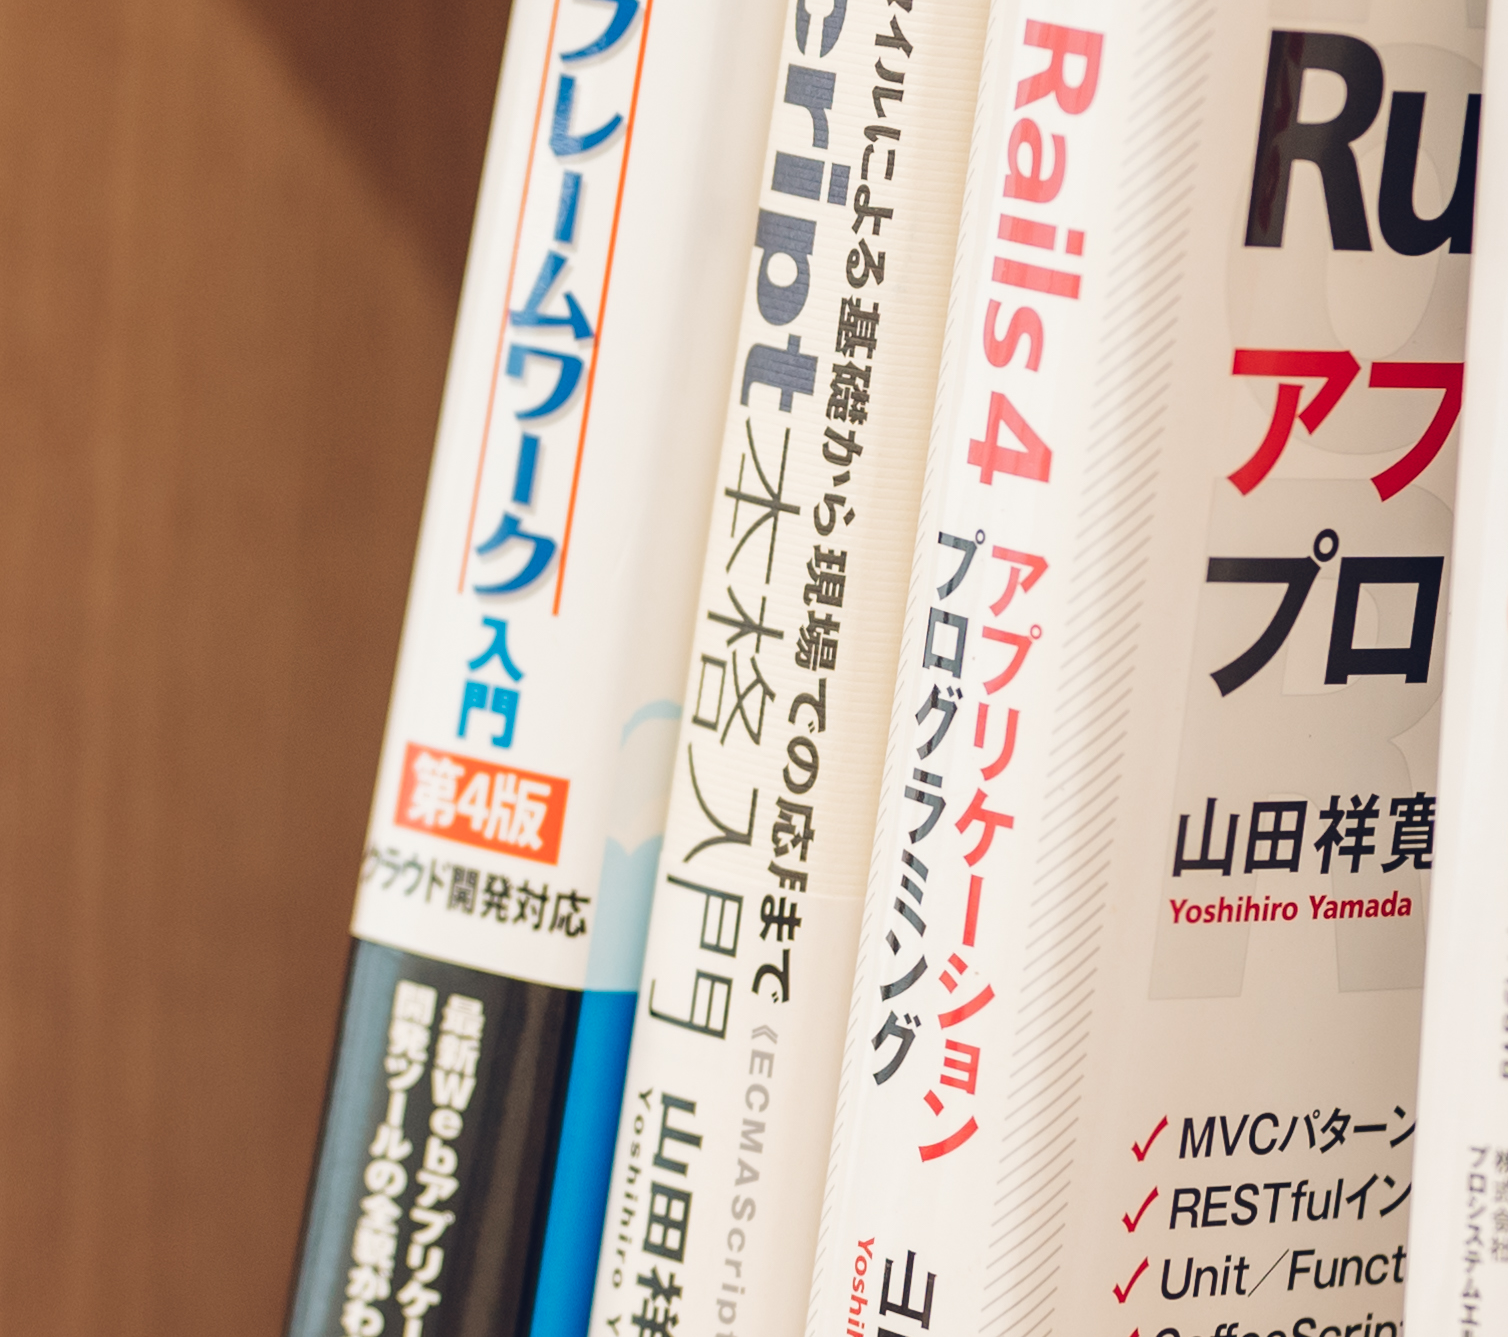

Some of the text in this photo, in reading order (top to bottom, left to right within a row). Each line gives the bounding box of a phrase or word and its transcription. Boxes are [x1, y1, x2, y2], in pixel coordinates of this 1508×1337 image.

[983, 18, 1105, 373] Rails
[1243, 28, 1484, 257] Ru
[966, 390, 1054, 486] 4
[1205, 528, 1446, 699] プロ
[407, 750, 554, 852] 第4版
[872, 528, 986, 1087] プログラミング
[917, 543, 1051, 1164] アプリケーション
[1171, 789, 1438, 879] 山田祥寛
[1168, 891, 1414, 926] Yoshihiro Yamada
[610, 1087, 654, 1290] Yoshihiro
[1178, 1105, 1417, 1160] MVCパターン
[1169, 1173, 1412, 1231] RESTfulイン
